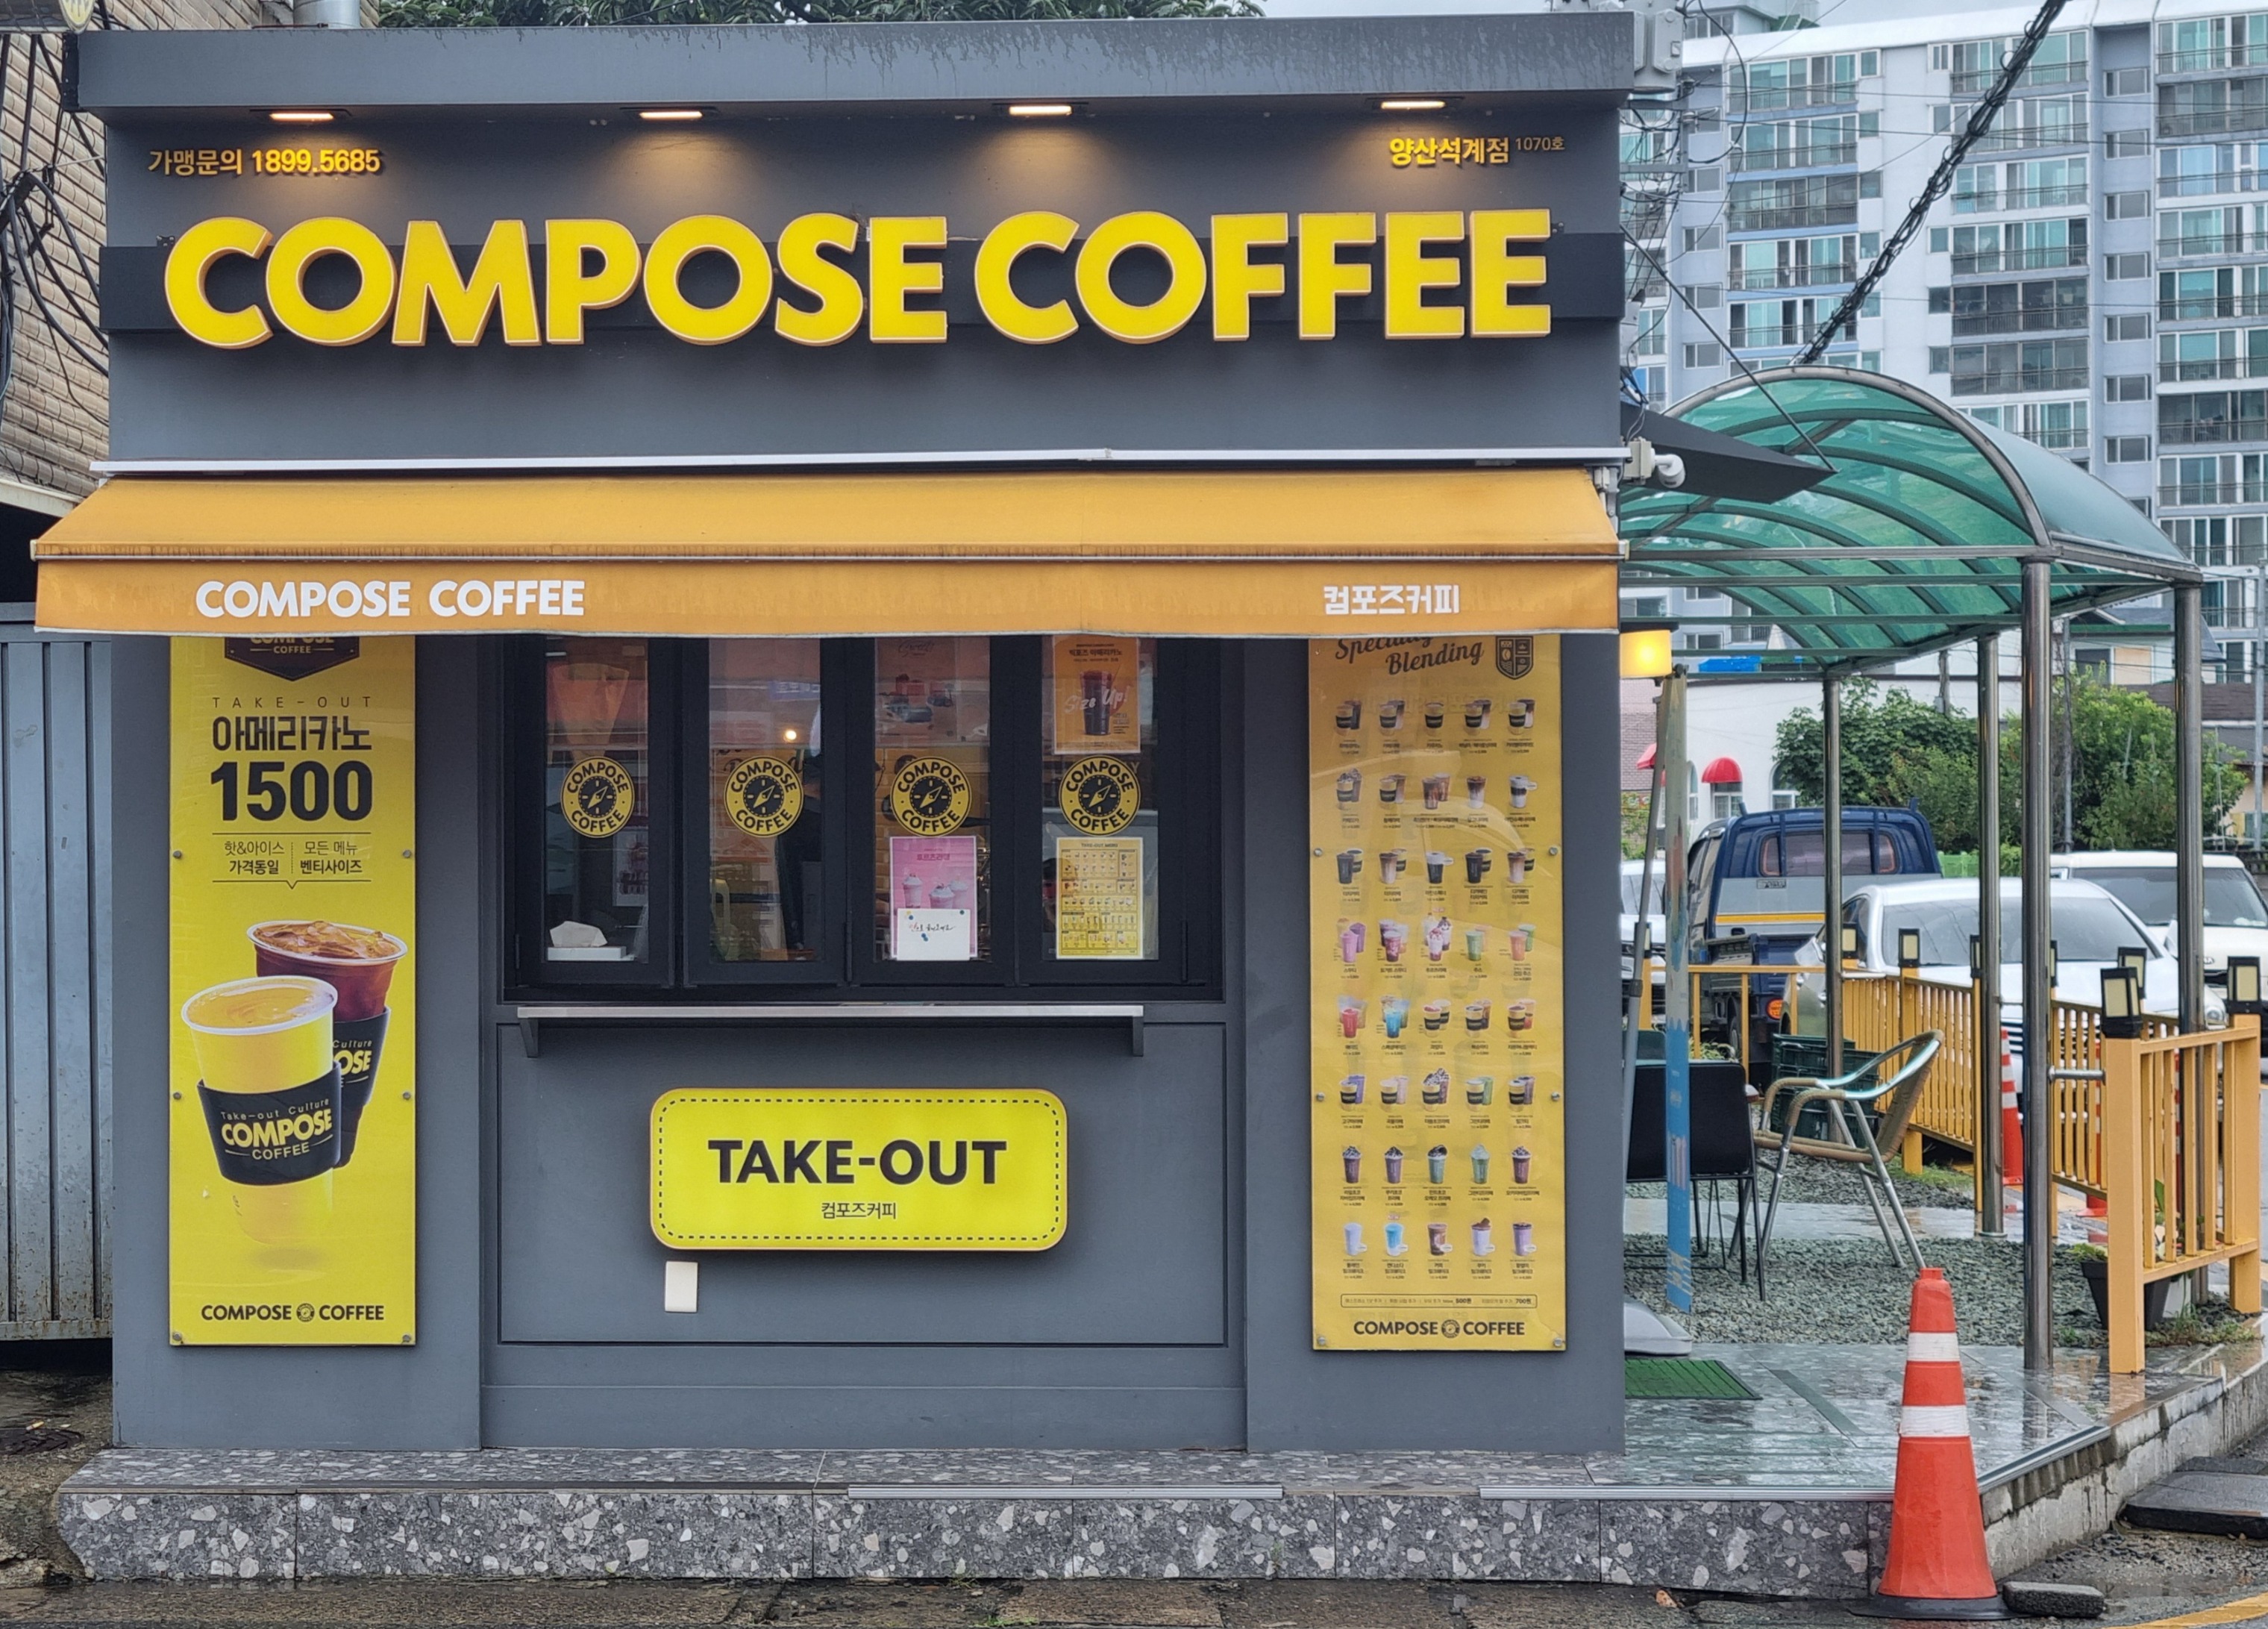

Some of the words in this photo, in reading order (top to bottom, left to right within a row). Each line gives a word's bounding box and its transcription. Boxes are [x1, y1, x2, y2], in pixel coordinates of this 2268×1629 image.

[1388, 137, 1509, 166] 양산석계점
[1515, 135, 1565, 152] 1070호
[148, 148, 242, 177] 가맹문의
[251, 149, 380, 174] 1899.5685
[164, 213, 947, 349] COMPOSE
[974, 208, 1552, 344] COFFEE
[196, 581, 410, 618] COMPOSE
[429, 580, 585, 617] COFFEE
[1323, 584, 1459, 615] 컴포즈커피
[273, 645, 312, 654] COFFEE
[1385, 642, 1484, 675] Blending
[213, 696, 372, 708] TAKE-OUT
[213, 716, 372, 751] 아메리카노
[567, 762, 627, 793] COMPOSE
[731, 761, 796, 793] COMPOSE
[898, 761, 965, 793] COMPOSE
[1065, 760, 1134, 792] COMPOSE
[211, 760, 372, 821] 1500
[571, 810, 624, 833] COFFEE
[736, 809, 793, 832] COFFEE
[901, 810, 960, 833] COFFEE
[1070, 808, 1130, 831] COFFEE
[225, 841, 285, 856] 핫&아이스
[304, 841, 328, 854] 모든
[333, 841, 358, 856] 메뉴
[229, 860, 280, 875] 가격동일
[300, 860, 363, 874] 벤티사이즈
[333, 1040, 372, 1048] Culture
[221, 1110, 279, 1121] Take-out
[288, 1098, 330, 1116] Culture
[222, 1108, 333, 1148] COMPOSE
[251, 1142, 310, 1161] COFFEE
[708, 1139, 1007, 1184] TAKE-OUT
[821, 1202, 897, 1219] 컴포즈커피
[201, 1305, 292, 1321] COMPOSE
[319, 1305, 384, 1321] COFFEE
[1353, 1321, 1438, 1335] COMPOSE
[1463, 1322, 1525, 1336] COFFEE
